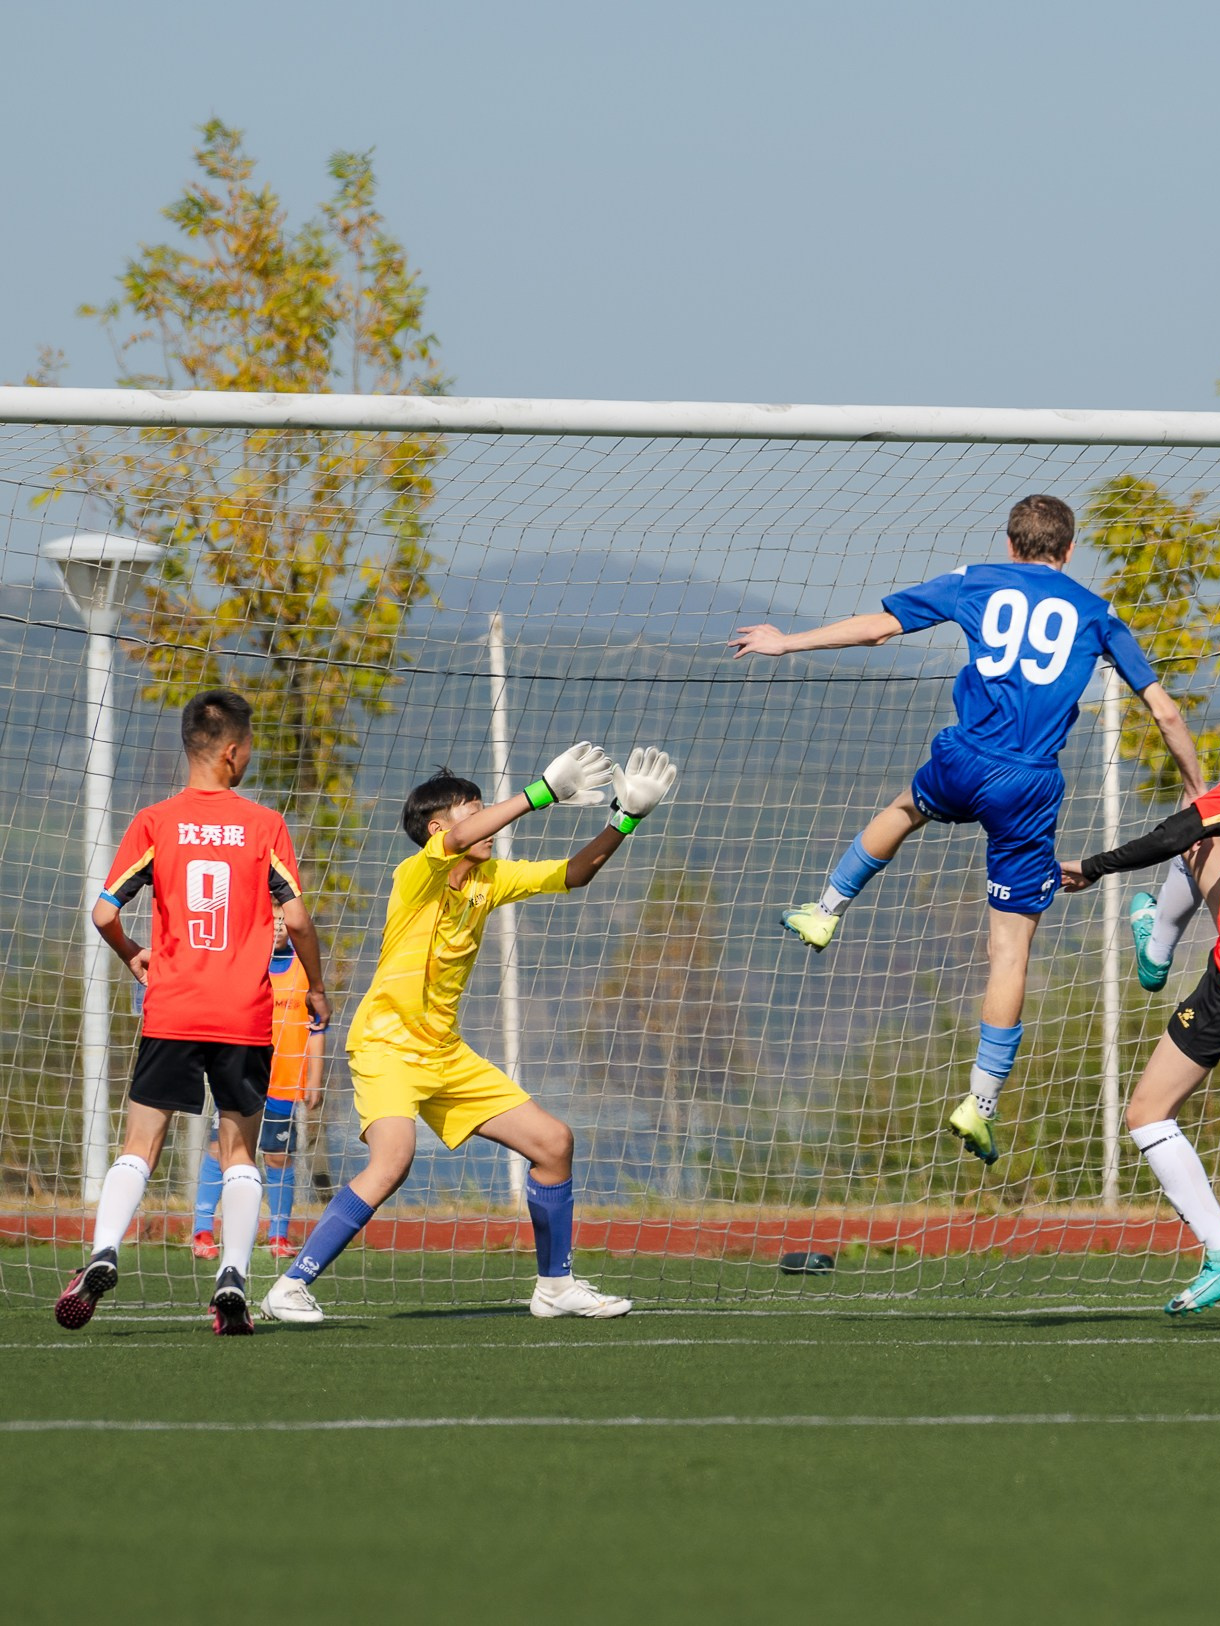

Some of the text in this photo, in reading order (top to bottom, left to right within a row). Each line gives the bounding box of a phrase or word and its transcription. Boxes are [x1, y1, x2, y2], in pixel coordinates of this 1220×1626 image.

[976, 588, 1079, 685] 99
[177, 822, 245, 847] 沈秀珉
[186, 859, 230, 951] 9
